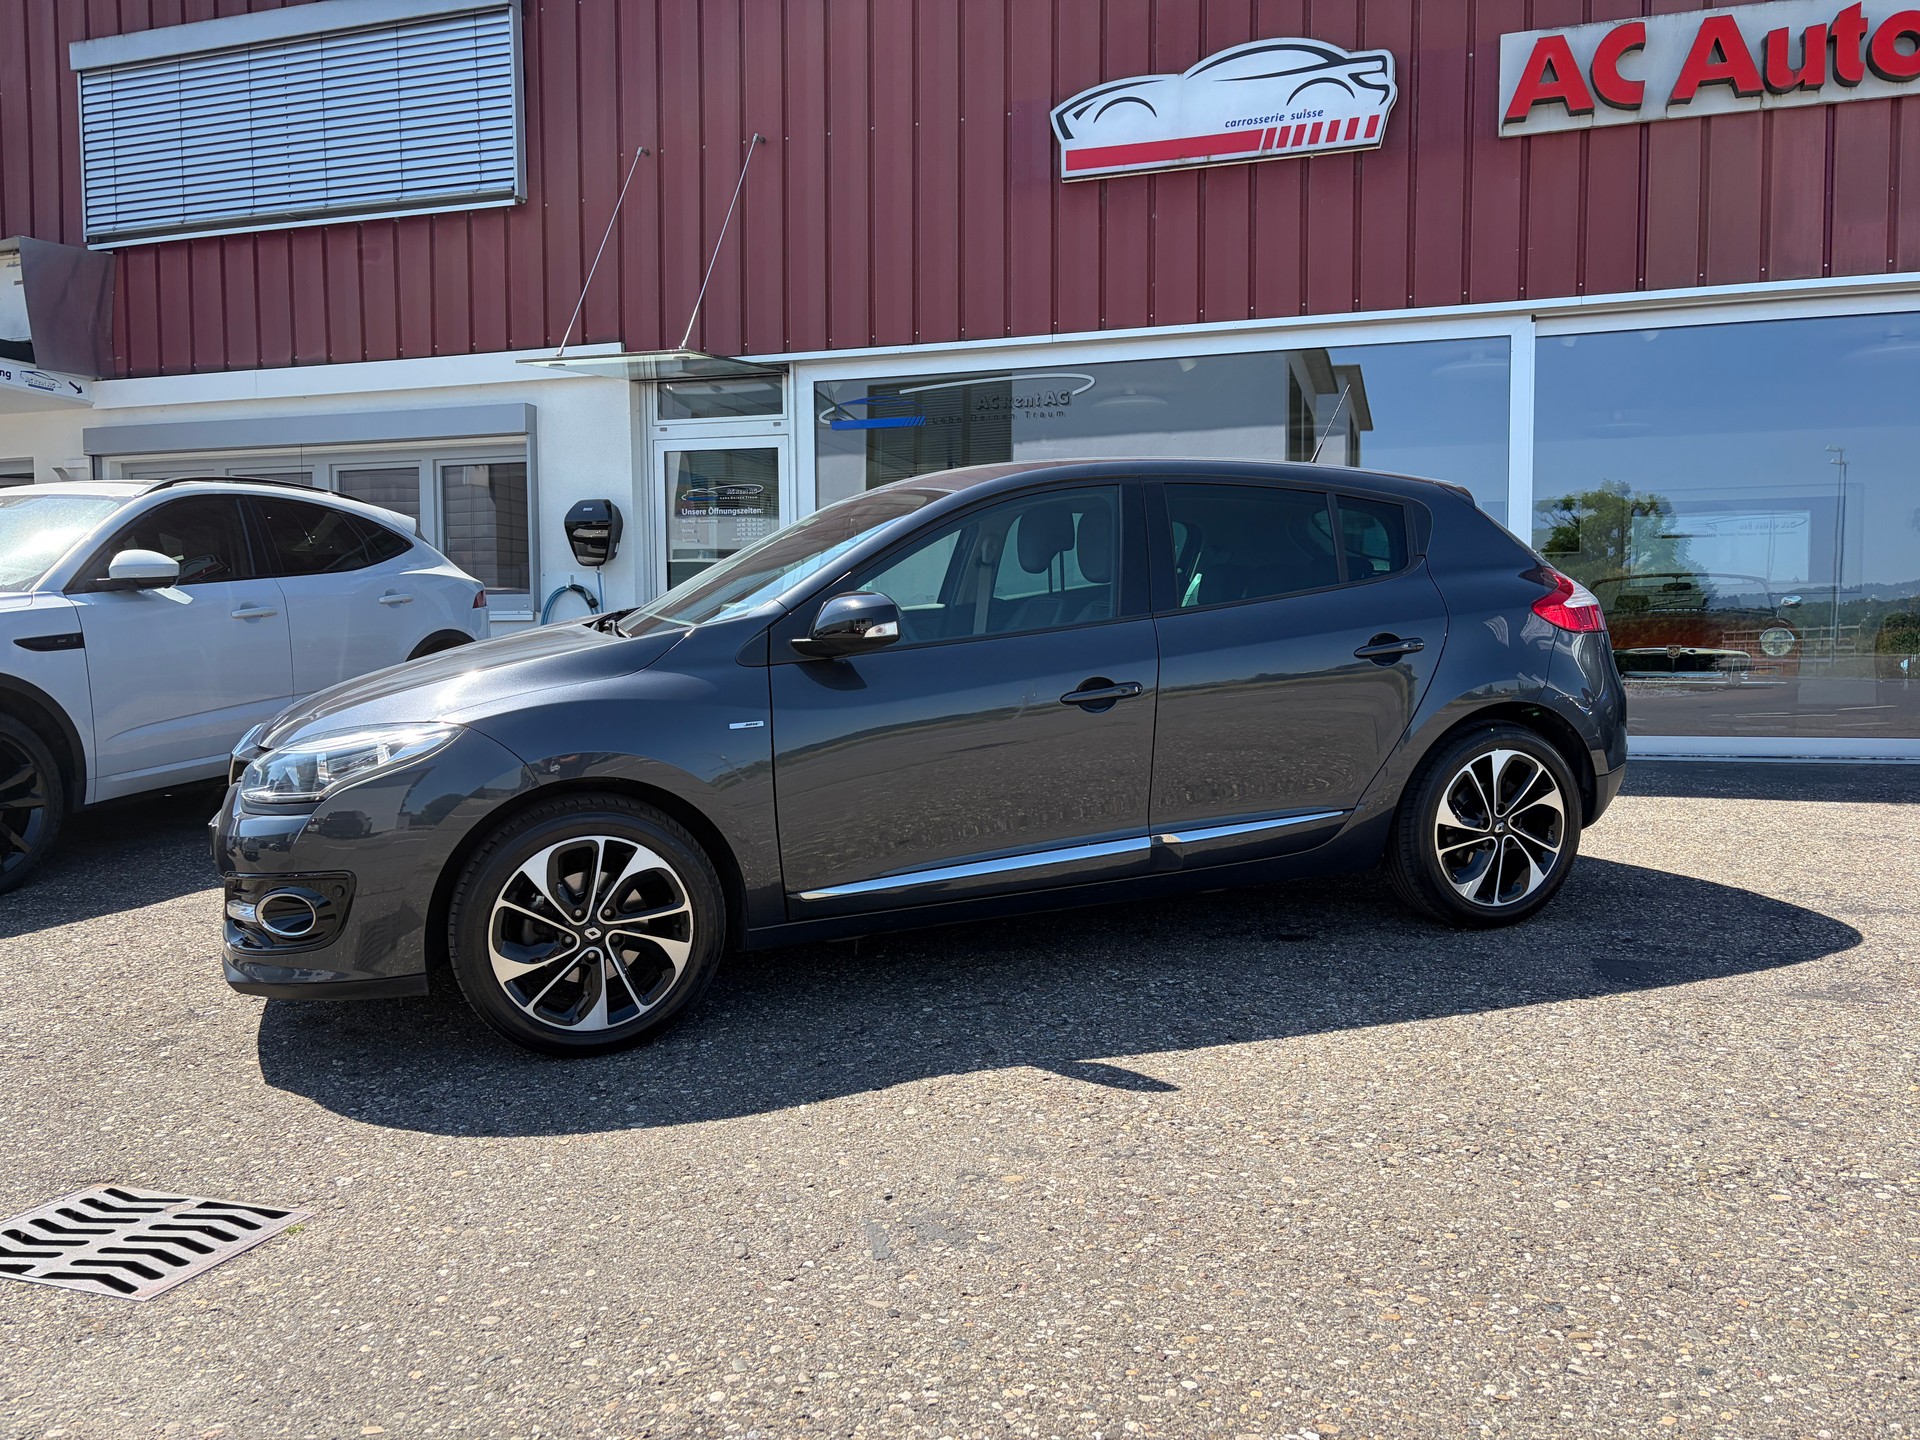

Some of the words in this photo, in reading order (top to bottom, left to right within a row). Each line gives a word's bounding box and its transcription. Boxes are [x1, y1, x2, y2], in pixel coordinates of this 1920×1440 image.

[1503, 21, 1647, 123] AC
[1667, 1, 1920, 105] Auto
[1225, 112, 1285, 128] carrosserie
[1290, 108, 1324, 120] suisse
[976, 394, 1000, 410] AC
[1043, 389, 1071, 407] AG
[1024, 410, 1065, 419] Traum
[681, 508, 706, 516] Unsere
[708, 506, 764, 516] Öffnungszeiten:
